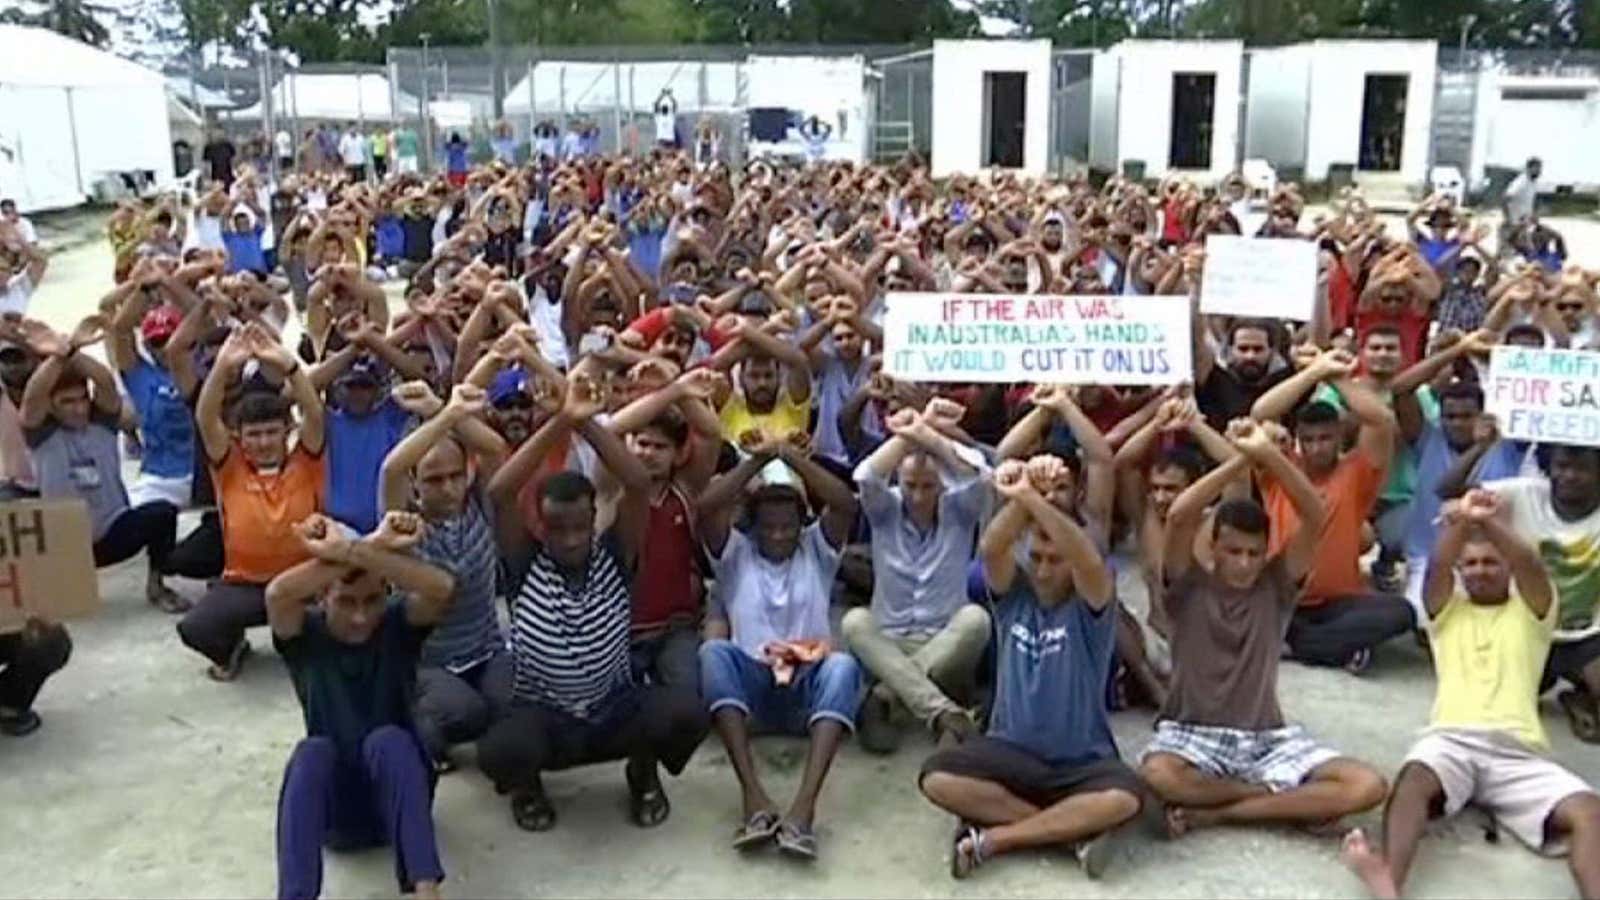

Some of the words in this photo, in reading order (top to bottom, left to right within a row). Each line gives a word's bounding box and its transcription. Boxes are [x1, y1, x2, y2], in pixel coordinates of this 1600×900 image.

[942, 299, 963, 322] IF
[969, 300, 1015, 321] THE
[1075, 299, 1125, 320] WAS
[908, 323, 929, 346] IN
[1084, 322, 1166, 343] HANDS
[894, 349, 915, 373] IT
[922, 349, 1005, 373] WOULD
[1020, 347, 1067, 373] CUT
[1103, 347, 1132, 373] ON
[1139, 347, 1171, 375] US
[1496, 376, 1552, 406] FOR
[0, 509, 47, 558] H
